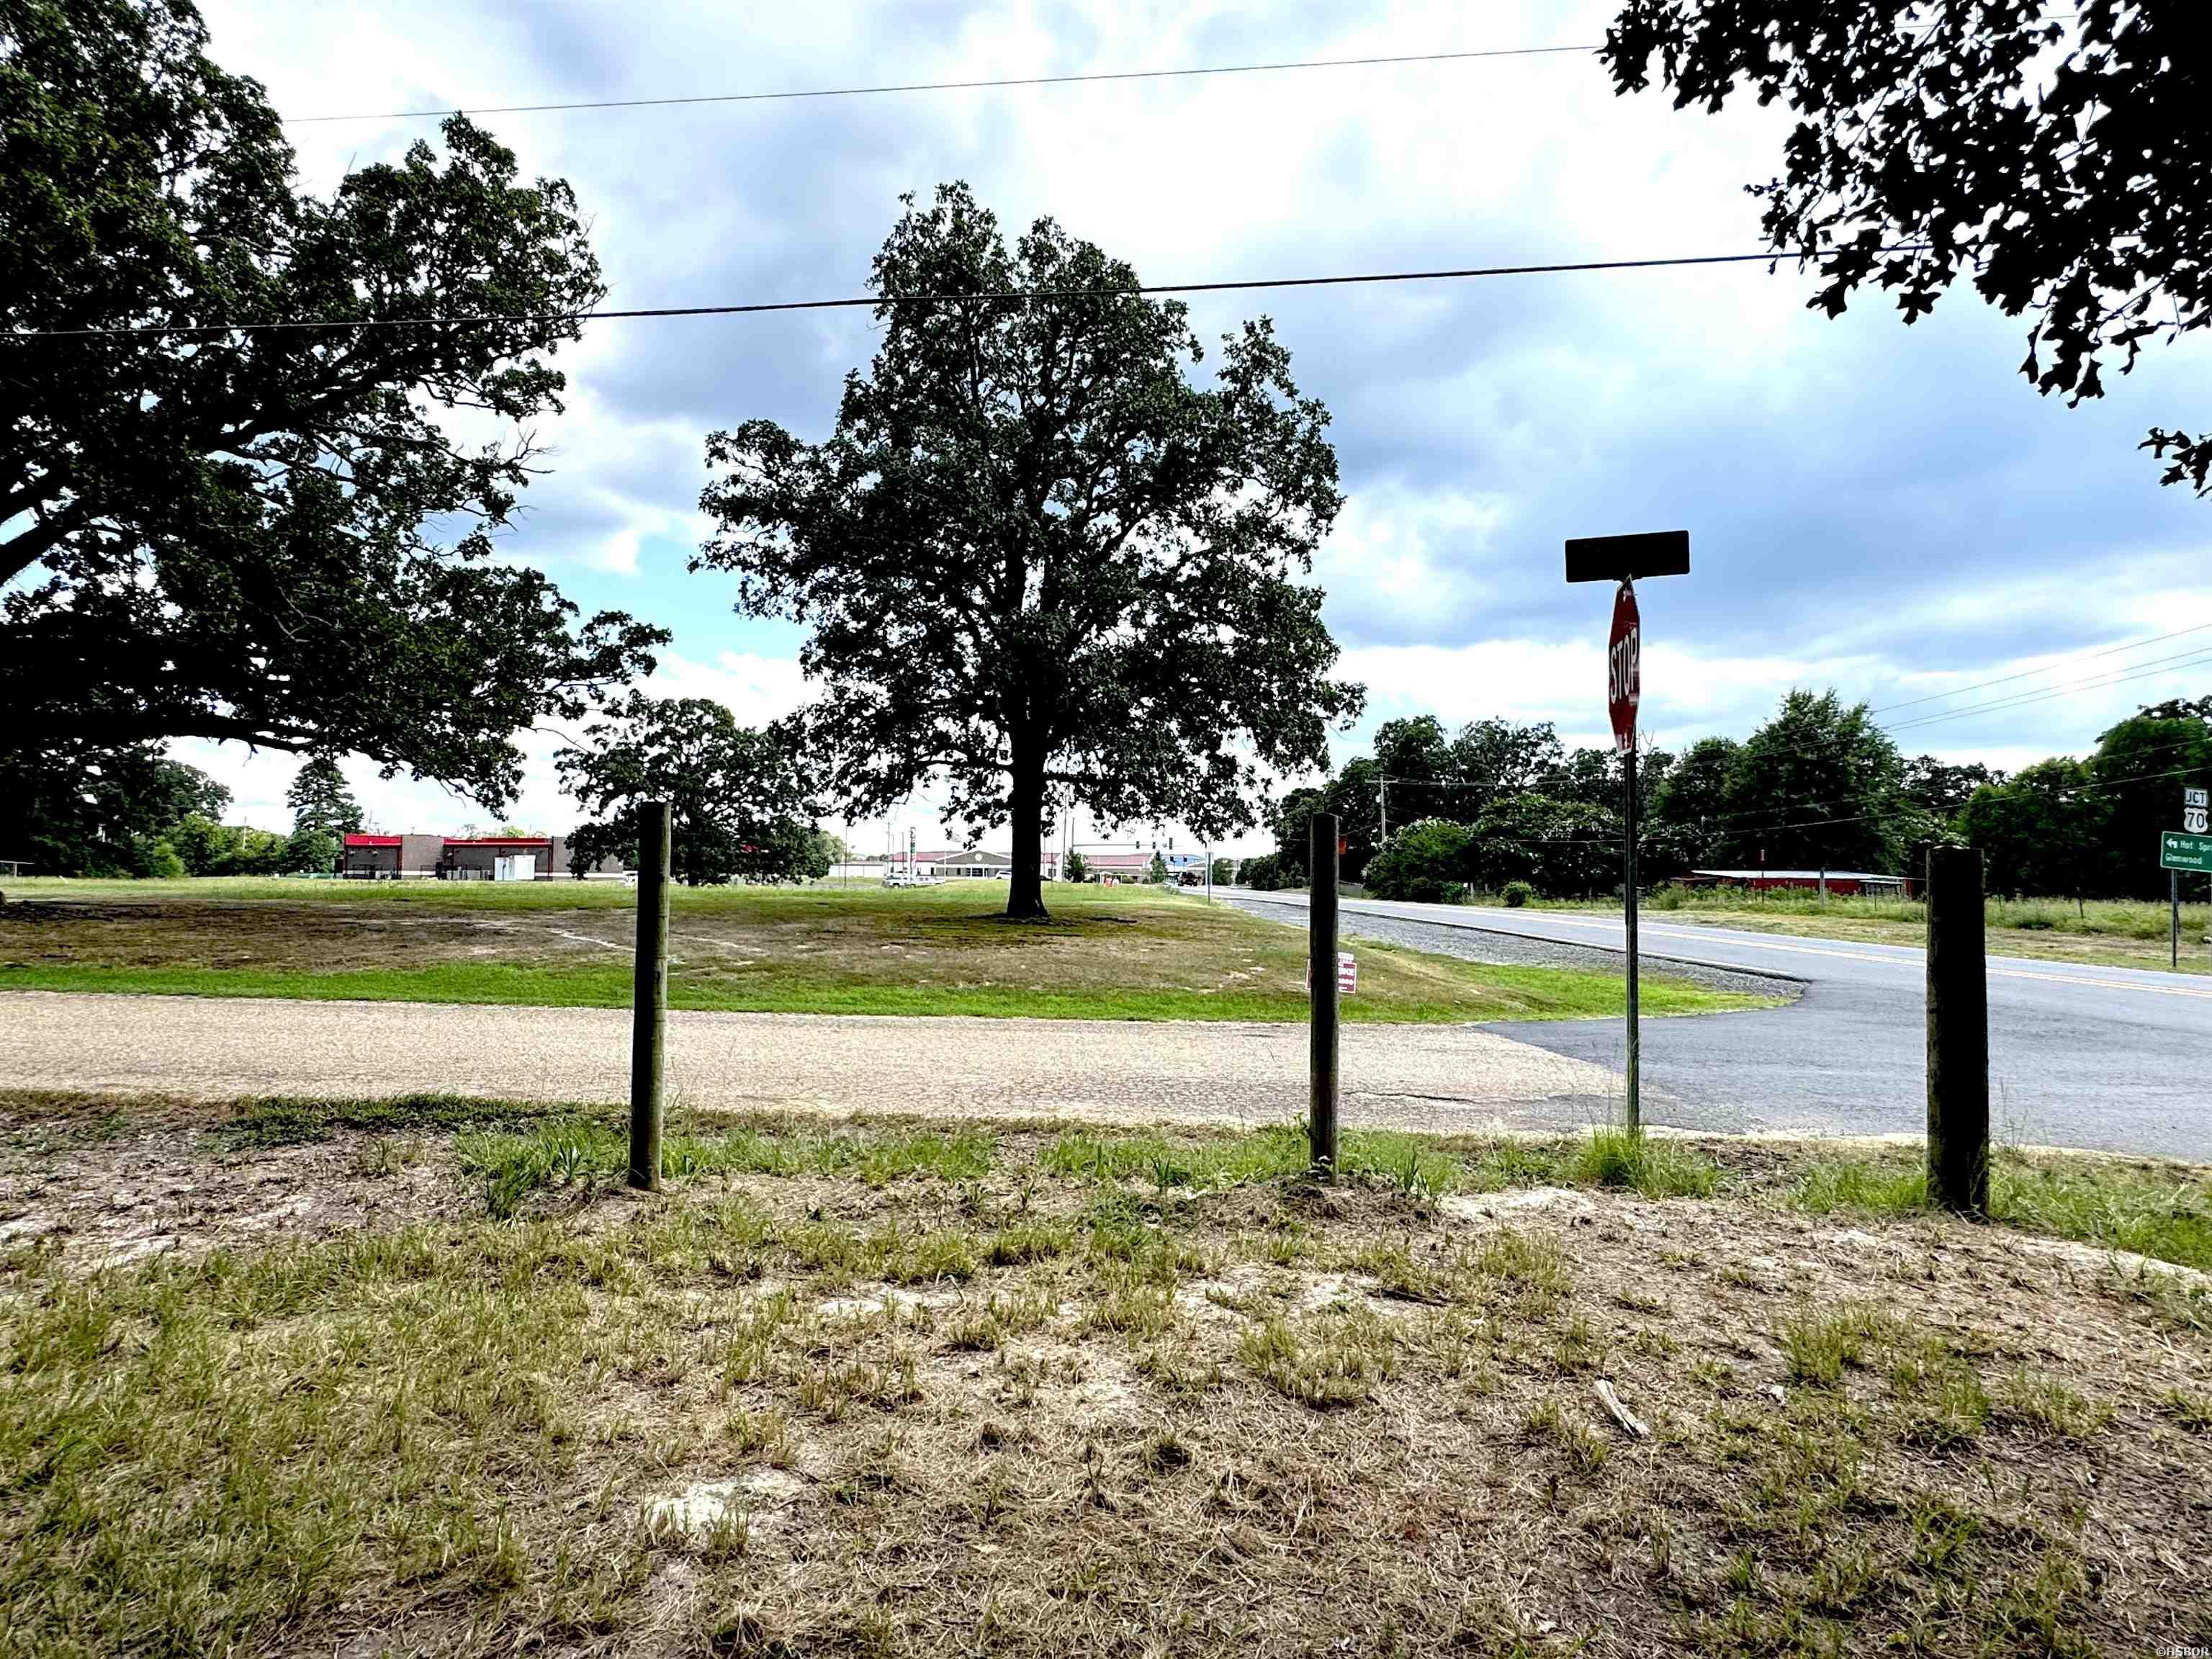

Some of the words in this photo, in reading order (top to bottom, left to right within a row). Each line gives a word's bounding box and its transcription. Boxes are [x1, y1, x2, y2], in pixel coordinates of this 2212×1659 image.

[1610, 628, 1637, 704] STOP
[2187, 793, 2205, 804] JCT
[2188, 812, 2205, 828] 70
[2180, 840, 2193, 850] Hot
